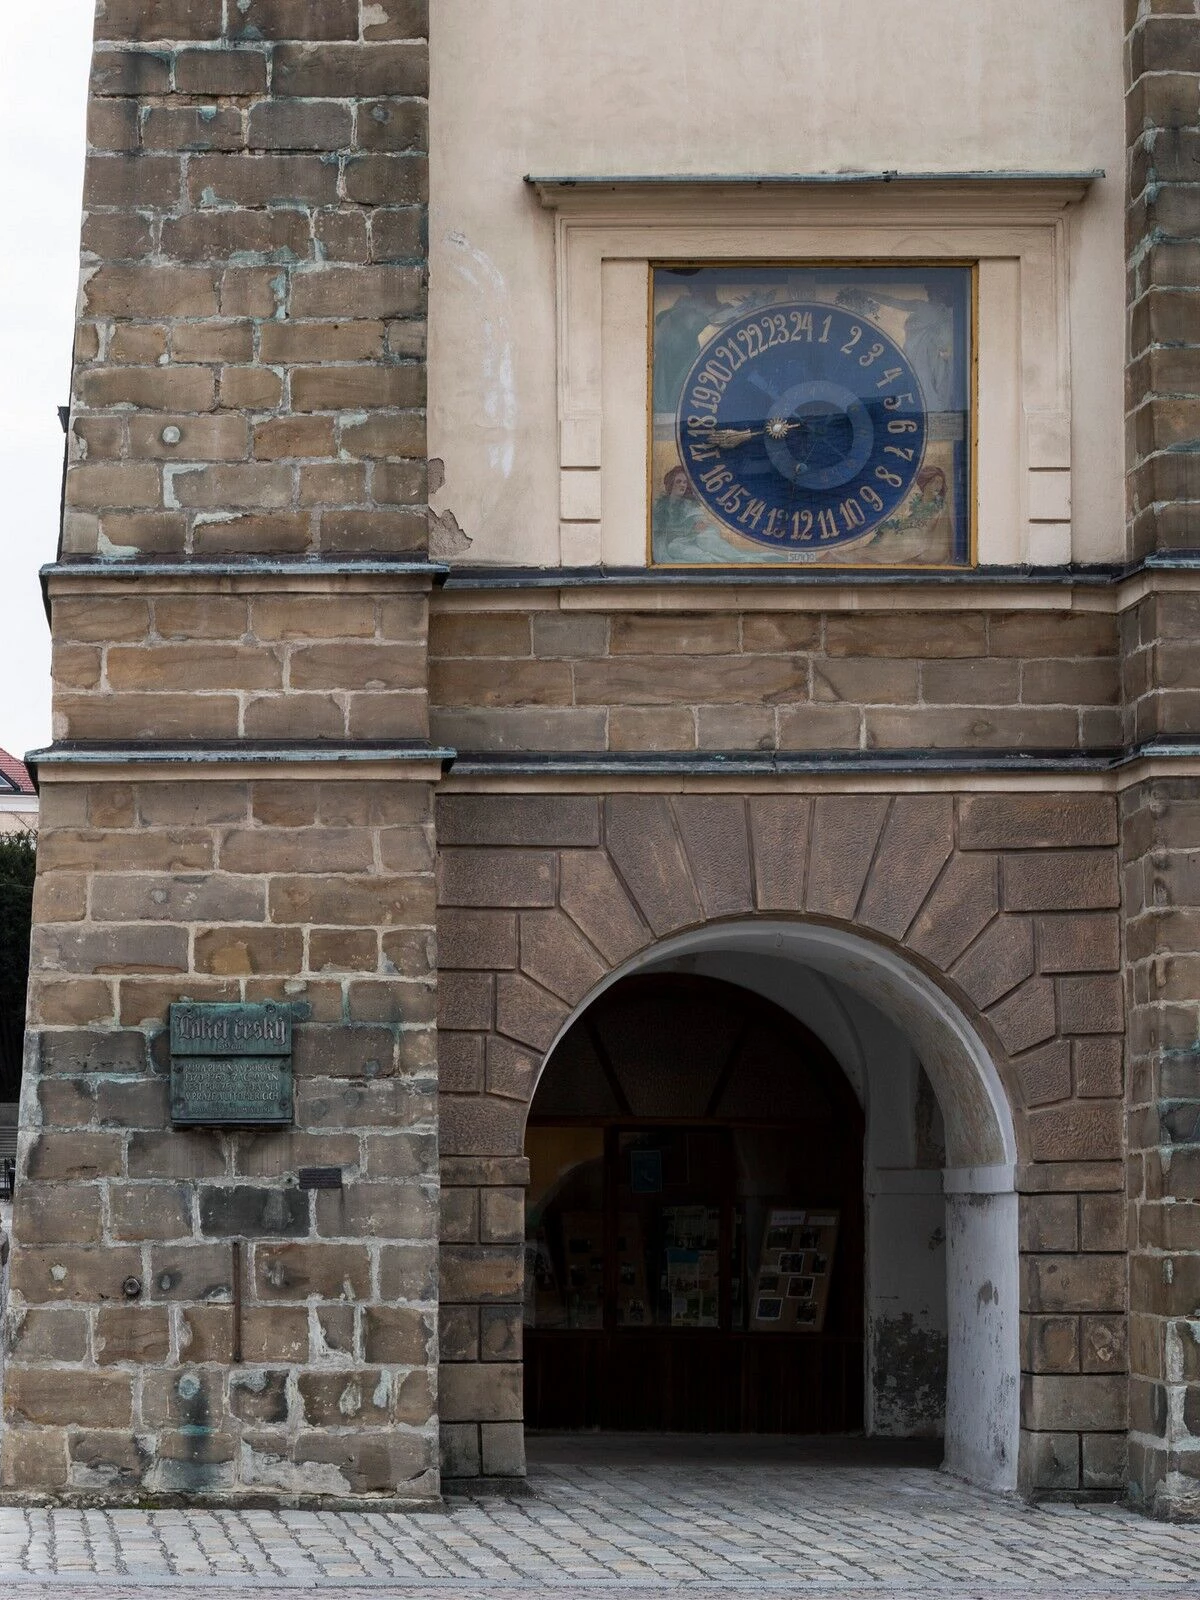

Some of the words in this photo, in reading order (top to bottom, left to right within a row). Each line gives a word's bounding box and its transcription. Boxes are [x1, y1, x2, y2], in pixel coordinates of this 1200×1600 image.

[737, 322, 769, 358] 22
[761, 314, 790, 346] 23
[789, 312, 813, 343] 24
[818, 316, 832, 343] 1
[840, 326, 862, 354] 2
[715, 339, 747, 371] 21
[859, 343, 884, 366] 3
[698, 359, 733, 392] 20
[875, 367, 902, 388] 4
[690, 387, 721, 413] 19
[884, 393, 914, 410] 5
[688, 415, 718, 437] 18
[888, 421, 917, 434] 6
[690, 443, 720, 461] 17
[884, 446, 913, 461] 7
[700, 464, 733, 492] 16
[875, 466, 902, 487] 8
[716, 484, 750, 513] 15
[737, 497, 766, 528] 14
[859, 486, 883, 511] 9
[790, 510, 813, 540] 12
[817, 508, 839, 538] 11
[840, 499, 865, 530] 10
